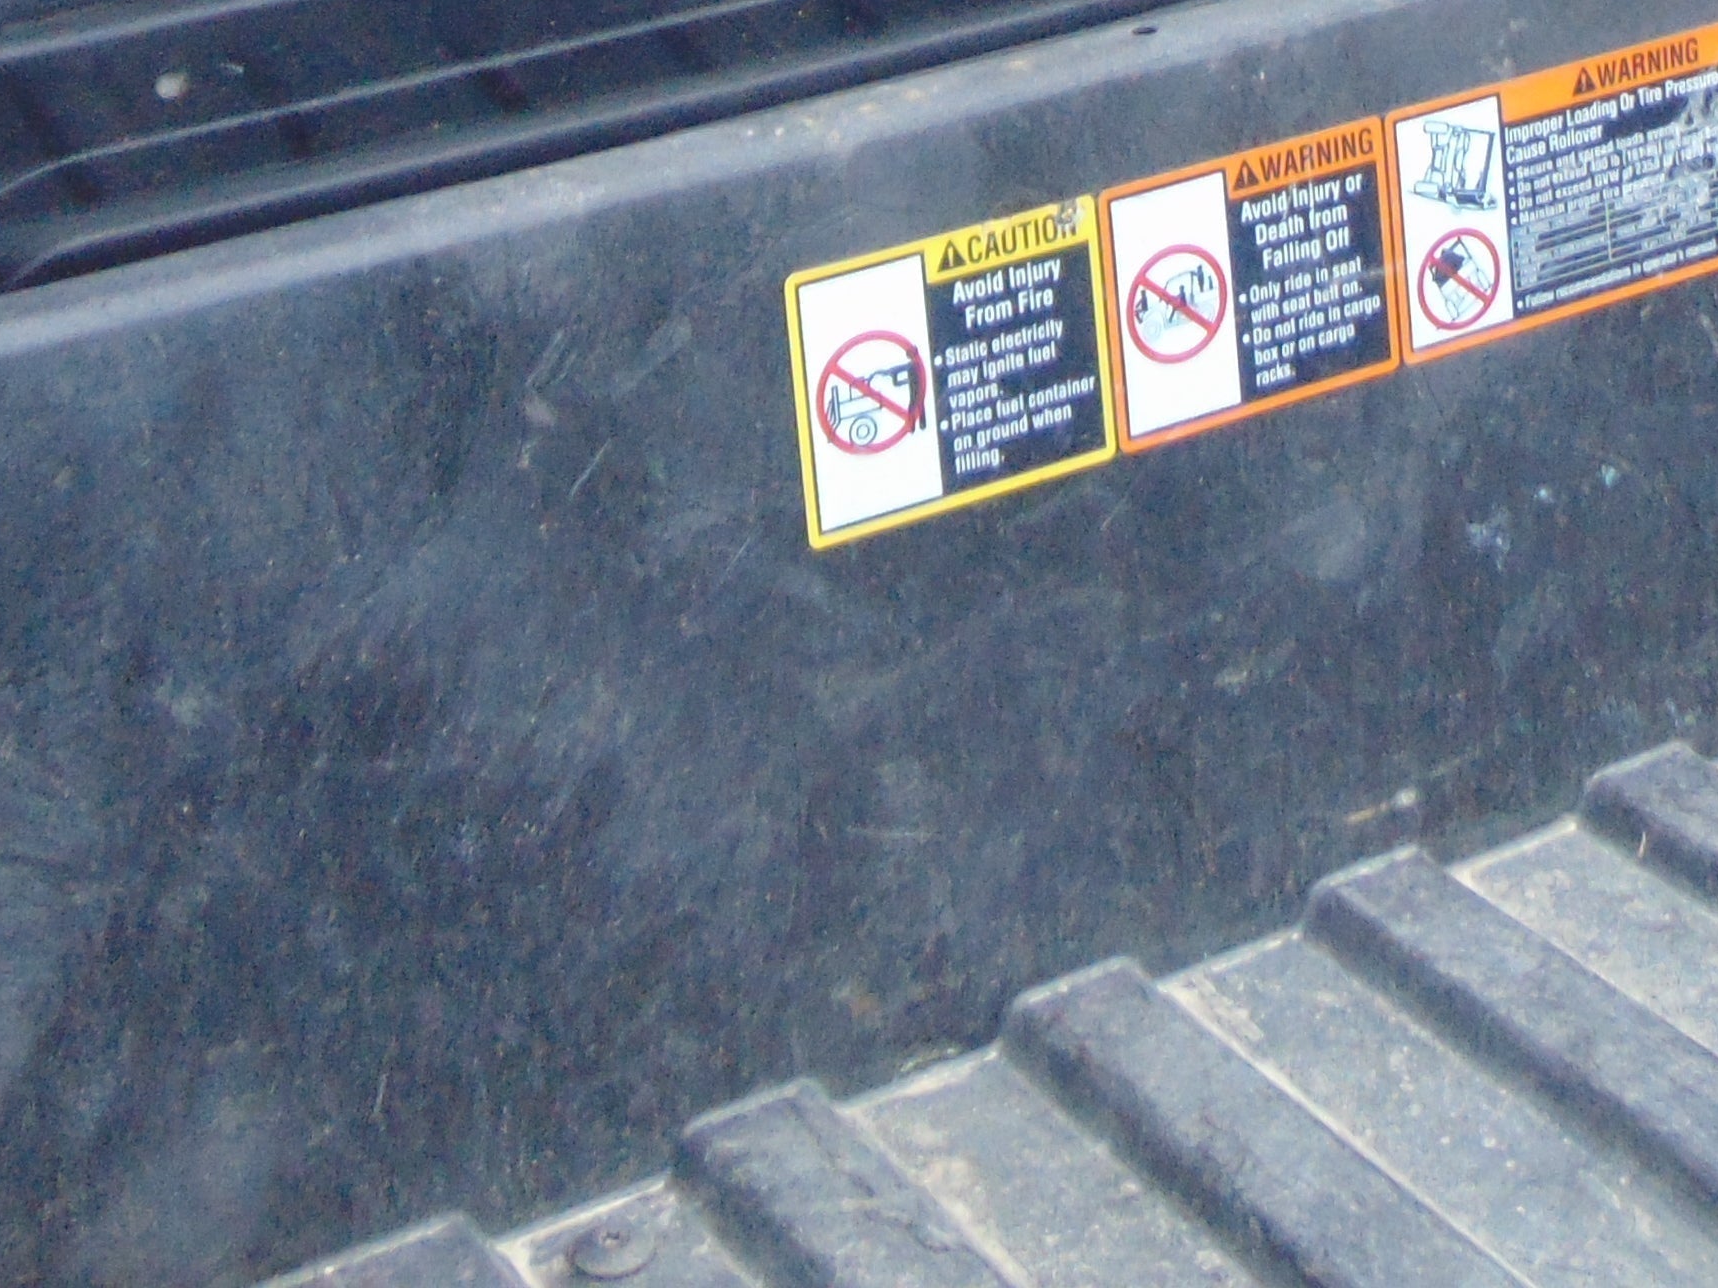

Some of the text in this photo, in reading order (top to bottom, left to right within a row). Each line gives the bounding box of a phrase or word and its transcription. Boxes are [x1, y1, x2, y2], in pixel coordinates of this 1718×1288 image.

[1596, 37, 1699, 89] WARNING
[1504, 115, 1563, 144] Improper
[1566, 99, 1618, 127] Loading
[1619, 92, 1636, 111] Or
[1637, 85, 1662, 106] Tire
[1259, 127, 1374, 182] WARNING
[1506, 125, 1604, 164] Cause Rollover
[1516, 159, 1553, 179] Secure
[1555, 151, 1576, 168] and
[1241, 173, 1363, 223] Avoid Injury or
[1254, 203, 1348, 246] Death from
[1262, 226, 1350, 270] Falling Off
[952, 258, 1061, 305] Avoid Injury
[1249, 255, 1362, 304] Only ride in seat
[1251, 279, 1364, 324] with seat belt on.
[964, 288, 1054, 329] From Fire
[1252, 294, 1381, 345] Do not ride in cargo
[945, 319, 1064, 366] Static electricity
[946, 340, 1057, 389] may ignite fuel
[1254, 323, 1356, 366] box or on cargo
[948, 382, 1005, 409] vapors.
[1255, 361, 1297, 388] racks.
[950, 375, 1096, 431] Place fuel container
[953, 404, 1073, 453] on ground when
[954, 447, 1006, 475] filling.
